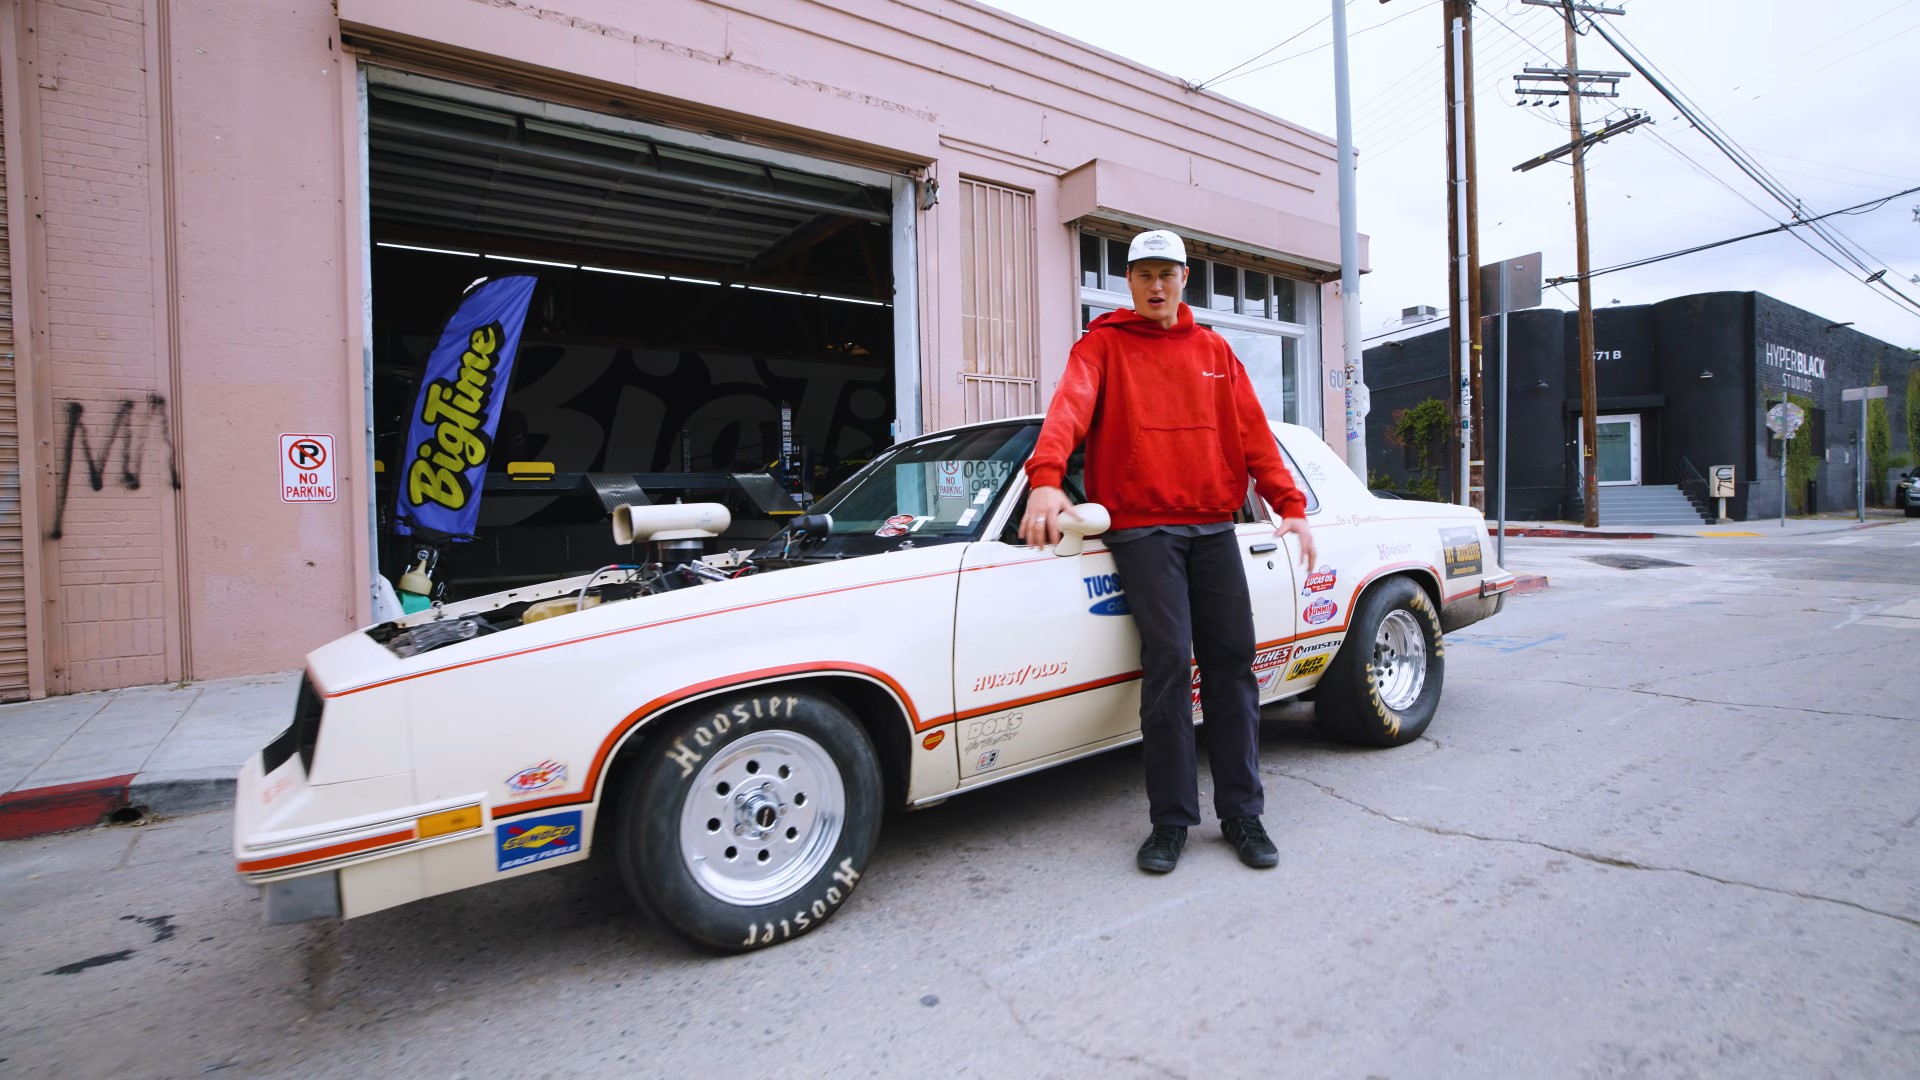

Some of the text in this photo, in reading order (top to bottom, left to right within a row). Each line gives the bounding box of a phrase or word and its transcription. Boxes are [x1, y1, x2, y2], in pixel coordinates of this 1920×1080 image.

[1612, 350, 1622, 360] B
[1765, 342, 1825, 379] HYPERBLACK
[1782, 372, 1812, 393] STUDIOS
[408, 322, 503, 511] BigTime
[299, 473, 318, 485] NO
[945, 476, 956, 485] NO
[286, 486, 332, 498] PARKING
[940, 485, 963, 495] PARKING
[1306, 574, 1334, 587] LUCAS OIL
[1303, 640, 1342, 653] MOSER
[1303, 656, 1324, 668] Auto
[665, 696, 799, 780] Hoosier
[504, 825, 575, 849] SUNOCO
[537, 844, 579, 861] FUELS
[743, 856, 861, 947] Hoosier
